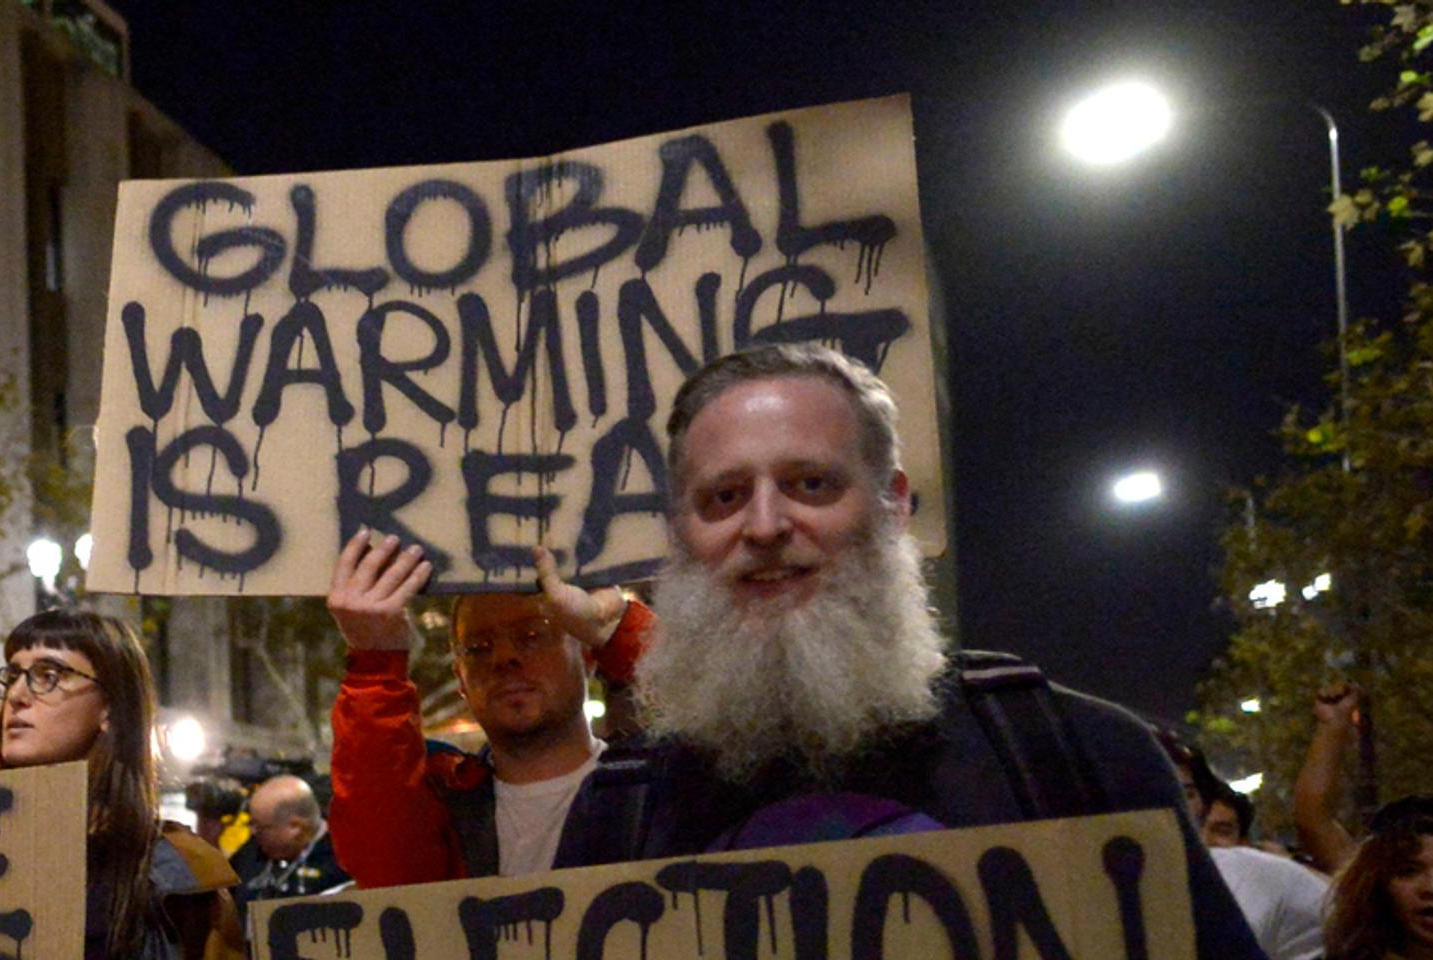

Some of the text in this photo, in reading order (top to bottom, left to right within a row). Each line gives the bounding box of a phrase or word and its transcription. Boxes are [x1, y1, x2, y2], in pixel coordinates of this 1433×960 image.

[150, 120, 898, 296] GLOBAL
[122, 265, 910, 434] WARMING
[127, 424, 282, 577] IS
